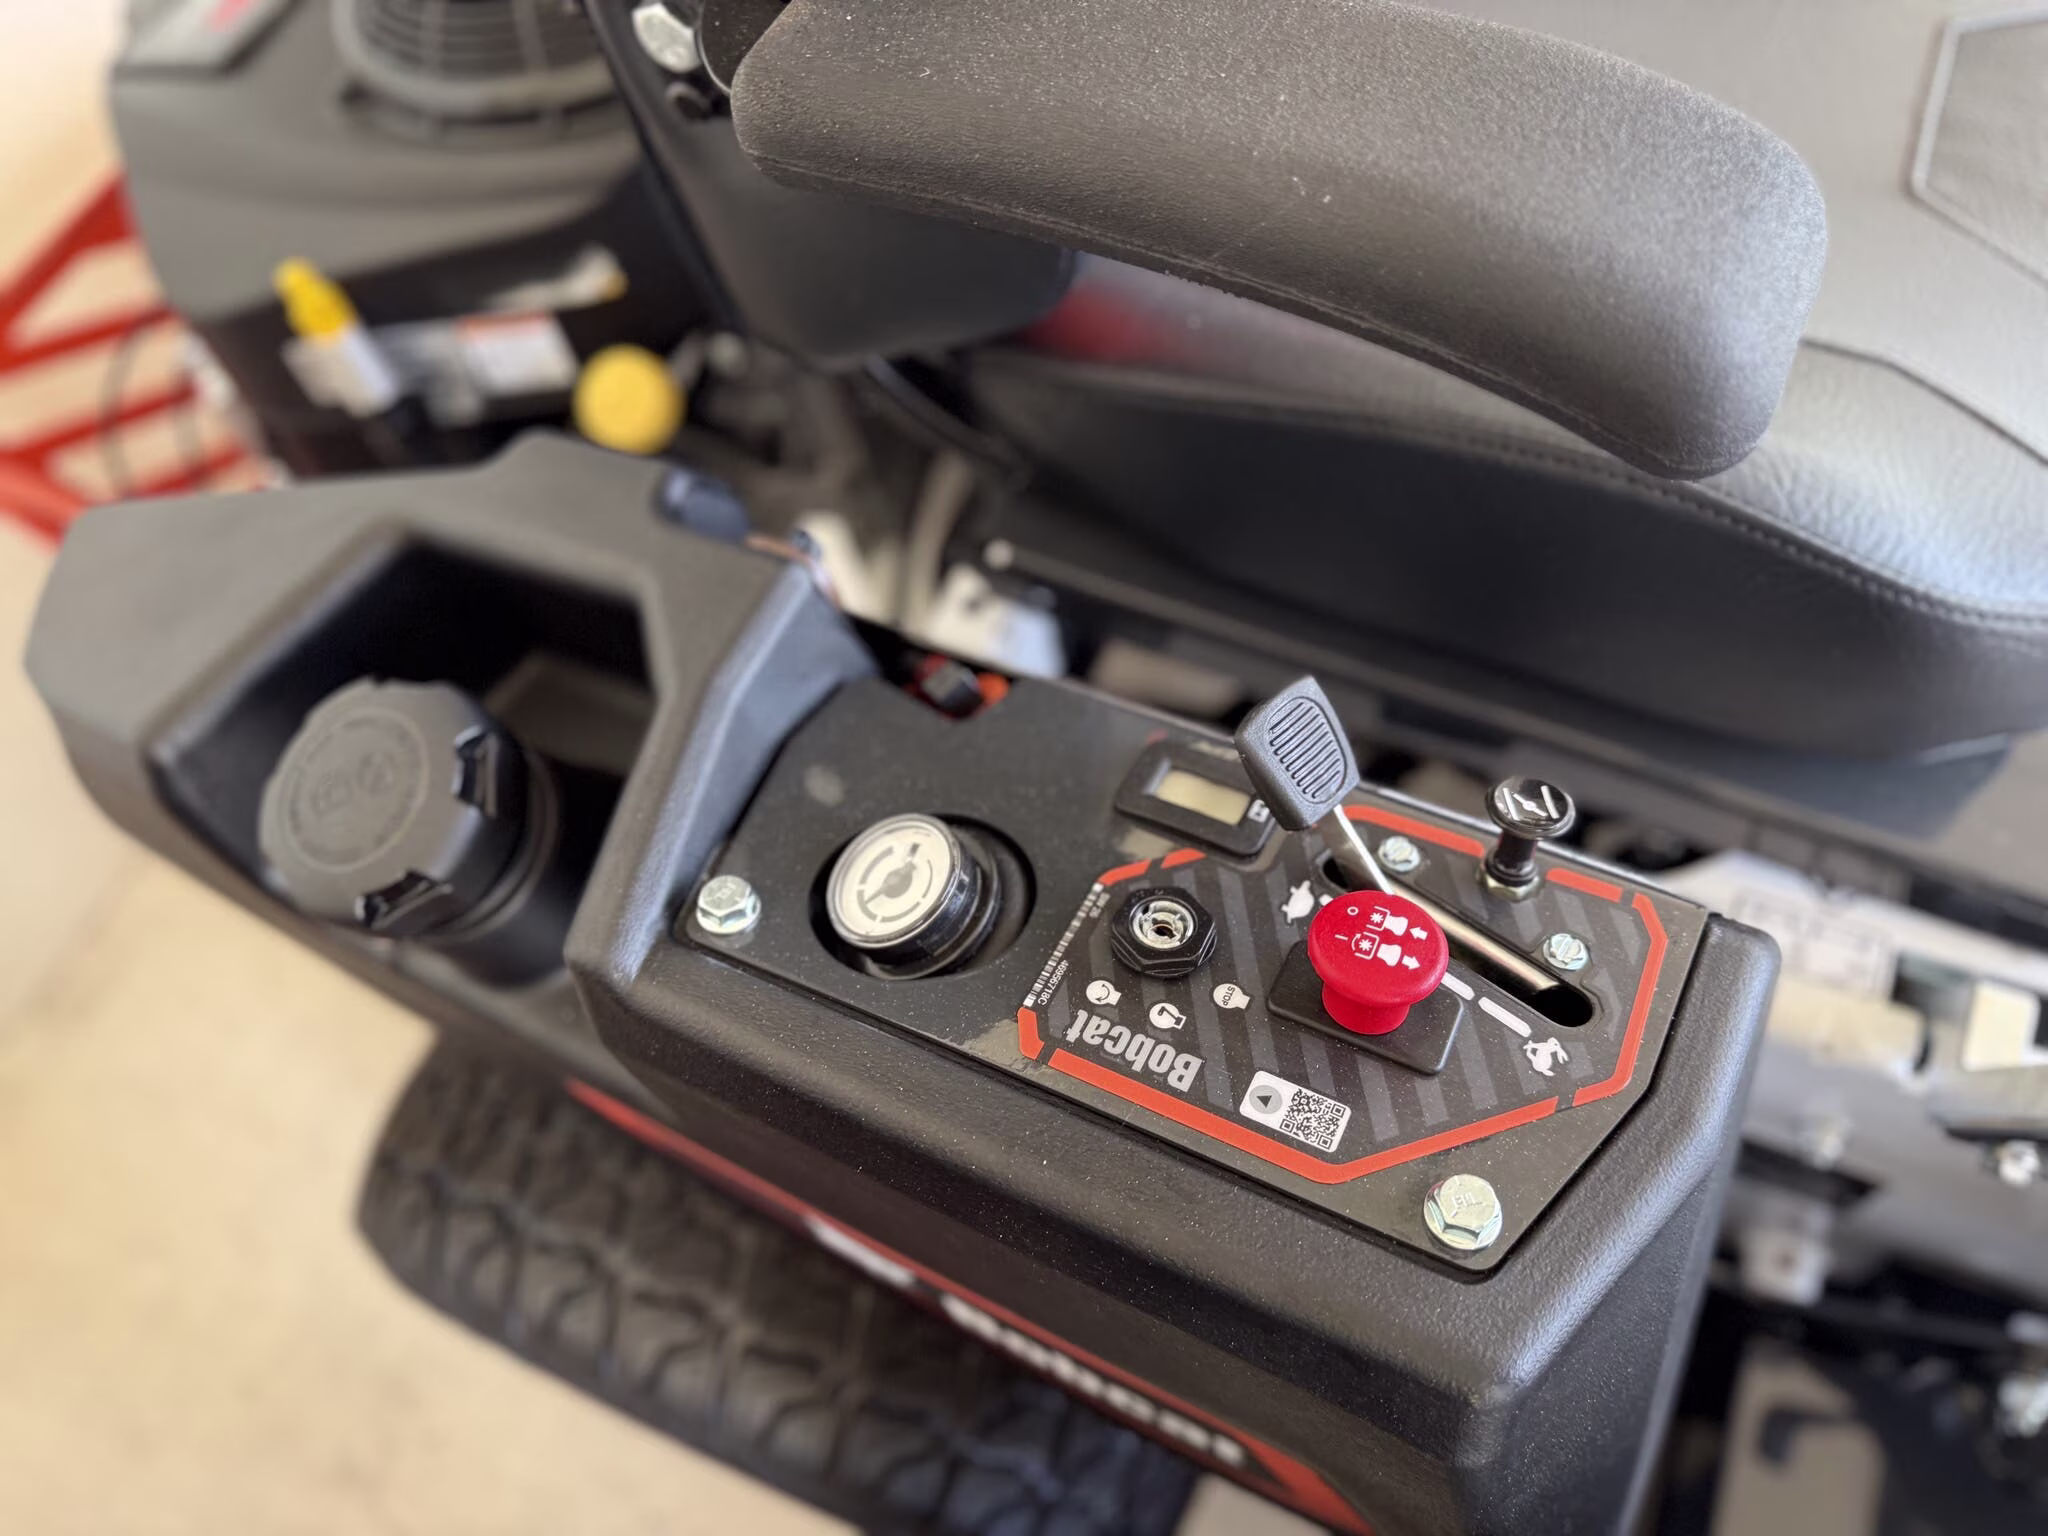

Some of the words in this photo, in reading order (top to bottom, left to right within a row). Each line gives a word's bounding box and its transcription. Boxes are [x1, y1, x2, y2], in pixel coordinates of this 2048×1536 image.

[1037, 959, 1069, 1006] 46956718C
[1222, 985, 1236, 1006] STOP
[1065, 1009, 1203, 1093] Bobcat
